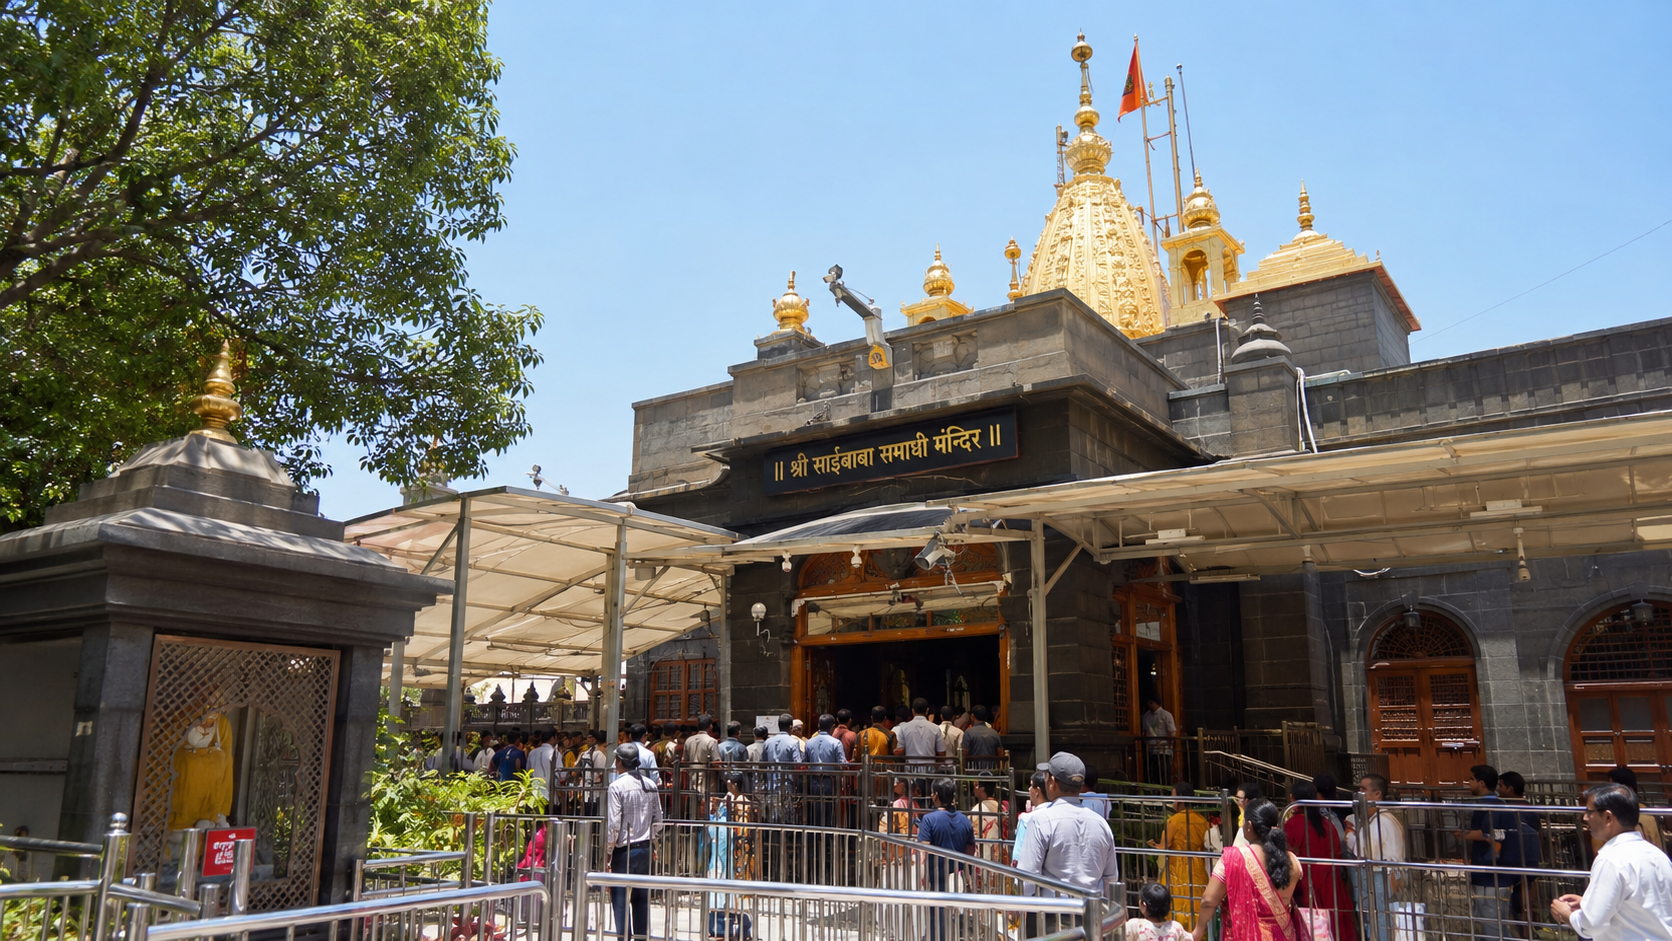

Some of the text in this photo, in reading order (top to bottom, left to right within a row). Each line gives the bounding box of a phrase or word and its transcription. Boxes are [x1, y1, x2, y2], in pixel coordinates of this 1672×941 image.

[790, 452, 809, 477] श्री
[811, 446, 875, 475] साईबाबा
[878, 432, 930, 464] समाधी
